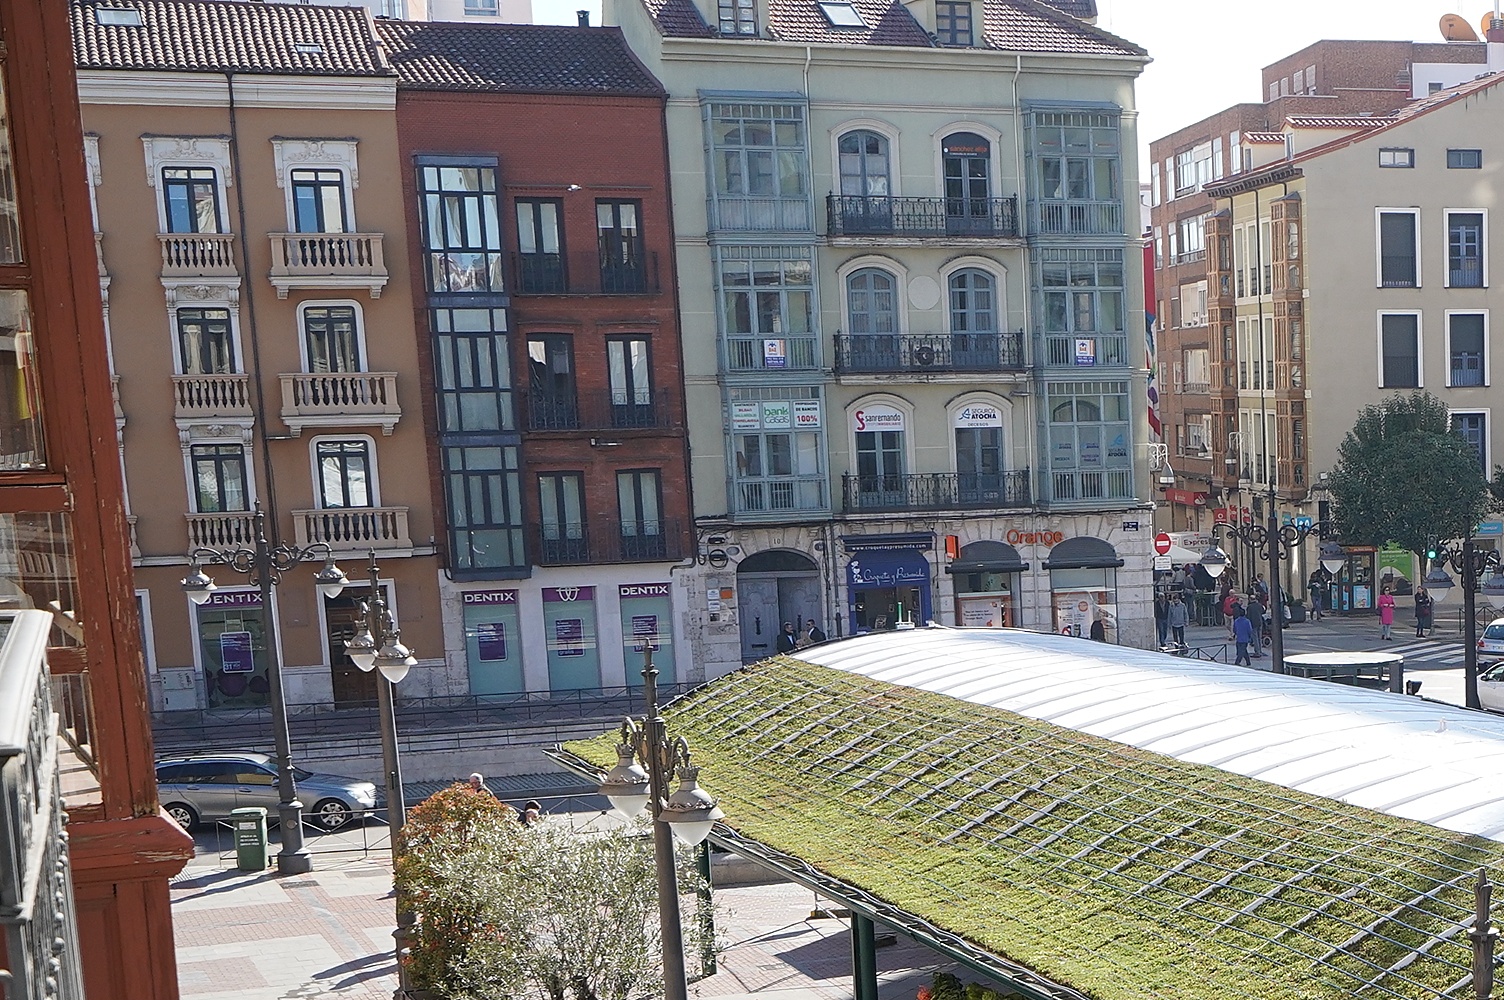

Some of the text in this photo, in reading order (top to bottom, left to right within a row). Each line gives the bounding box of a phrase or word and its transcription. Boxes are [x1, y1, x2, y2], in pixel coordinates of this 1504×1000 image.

[764, 407, 788, 416] bank
[765, 416, 790, 424] casas
[1006, 530, 1064, 546] Orange
[620, 585, 668, 596] DENTIX
[464, 592, 515, 603] DENTIX
